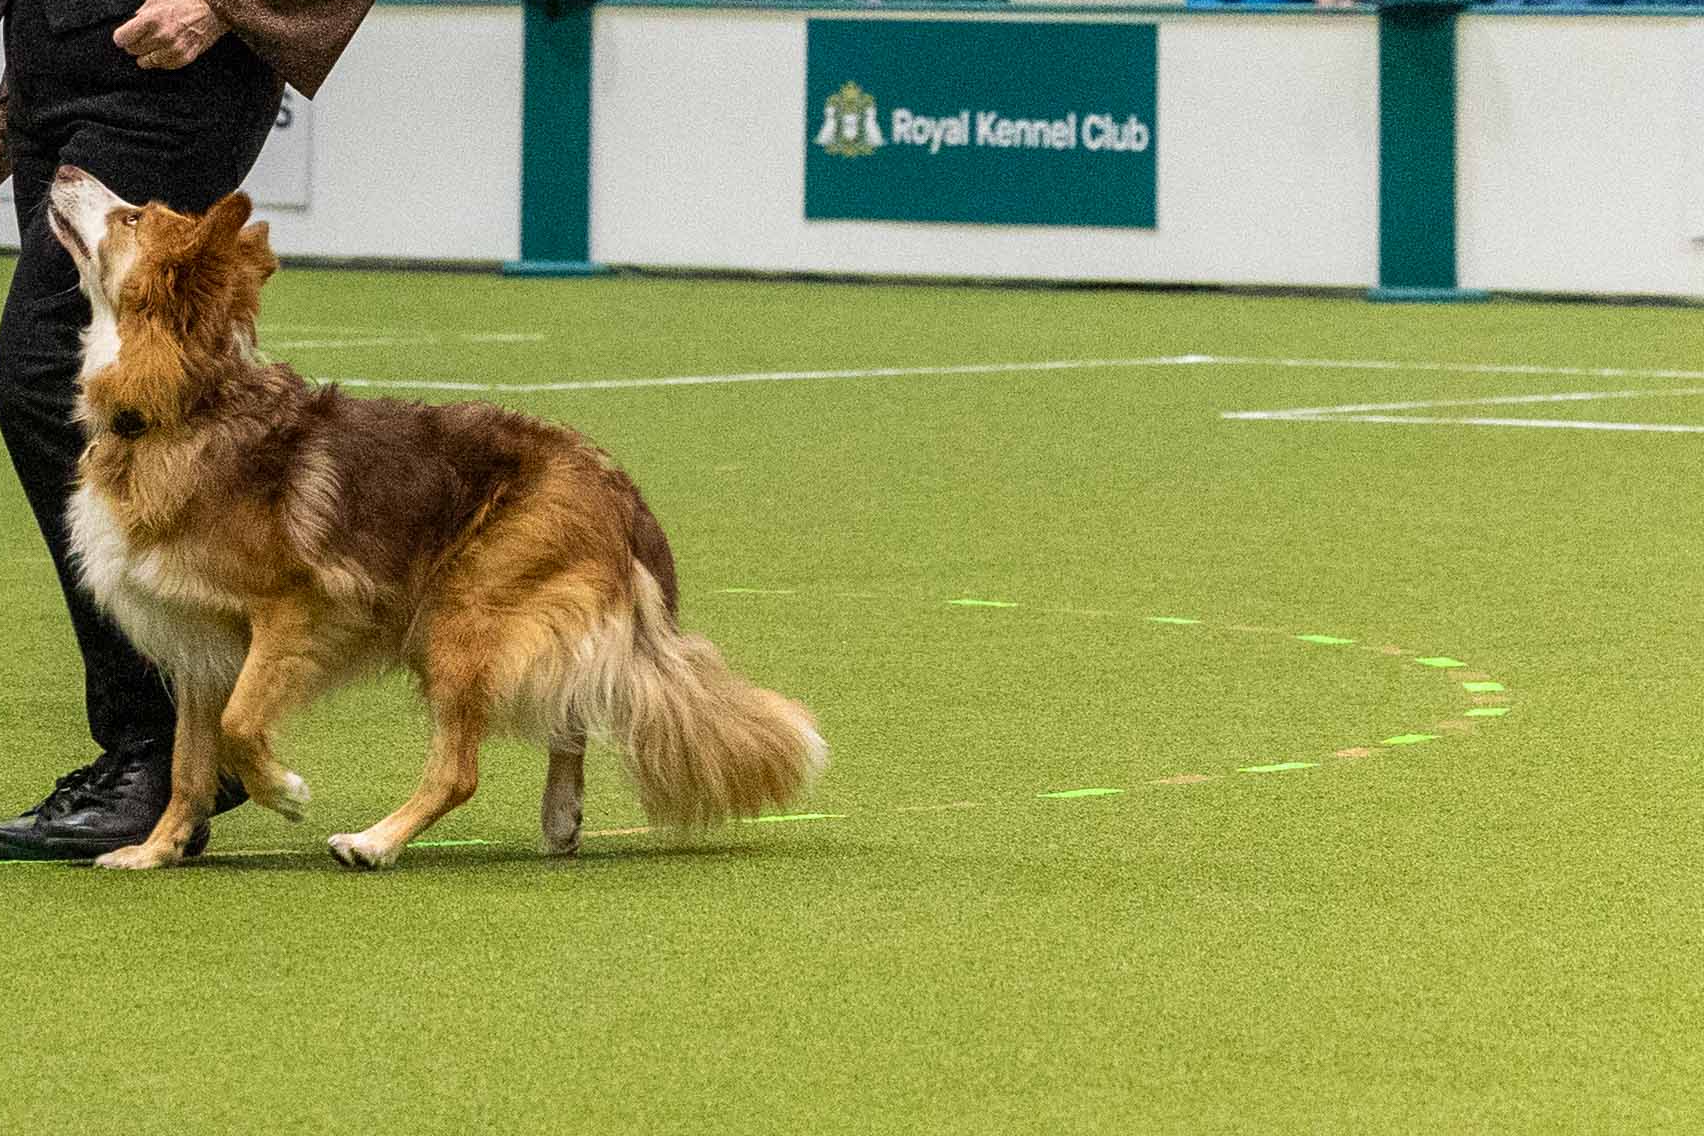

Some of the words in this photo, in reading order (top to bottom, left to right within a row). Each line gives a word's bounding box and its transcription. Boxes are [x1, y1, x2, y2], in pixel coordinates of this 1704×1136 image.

[891, 107, 970, 155] Royal
[975, 111, 1078, 151] Kennel
[1080, 113, 1150, 153] Club
